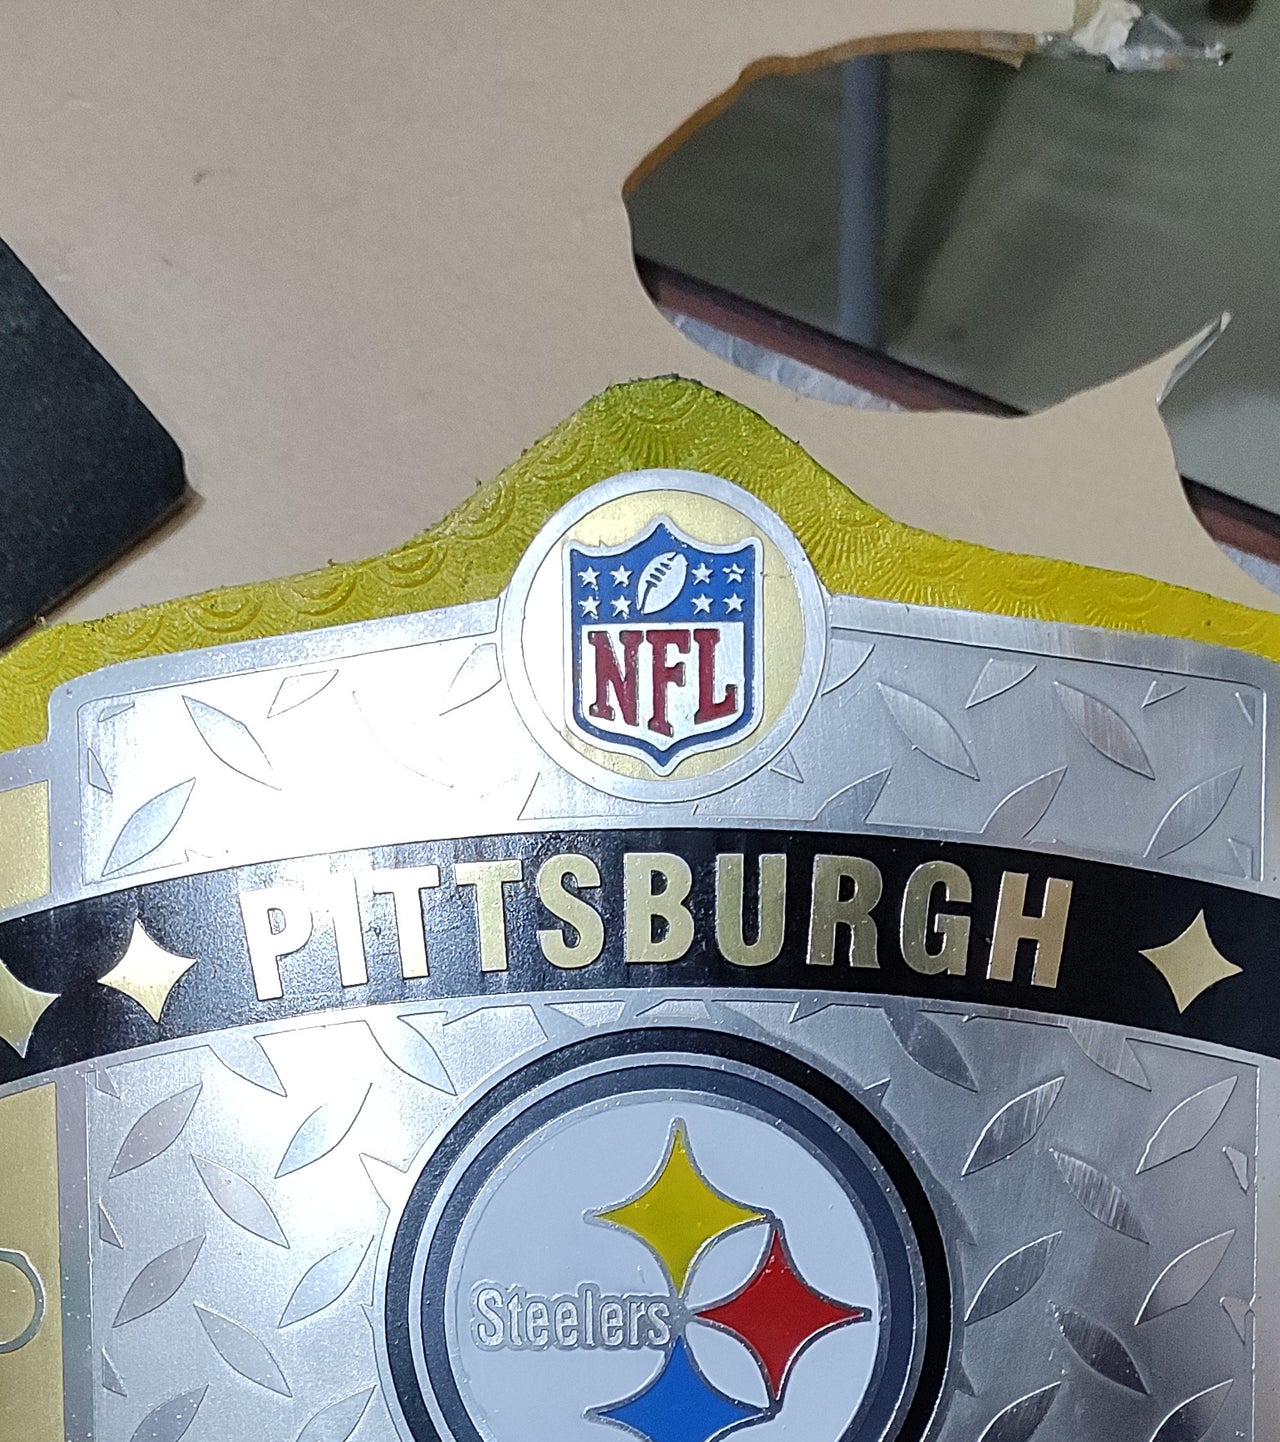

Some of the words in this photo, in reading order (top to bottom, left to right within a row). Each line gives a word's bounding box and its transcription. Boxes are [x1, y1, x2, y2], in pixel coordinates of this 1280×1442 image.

[588, 628, 739, 737] NFL
[239, 853, 1074, 1001] PITTSBURGH
[472, 1281, 677, 1350] Steelers
